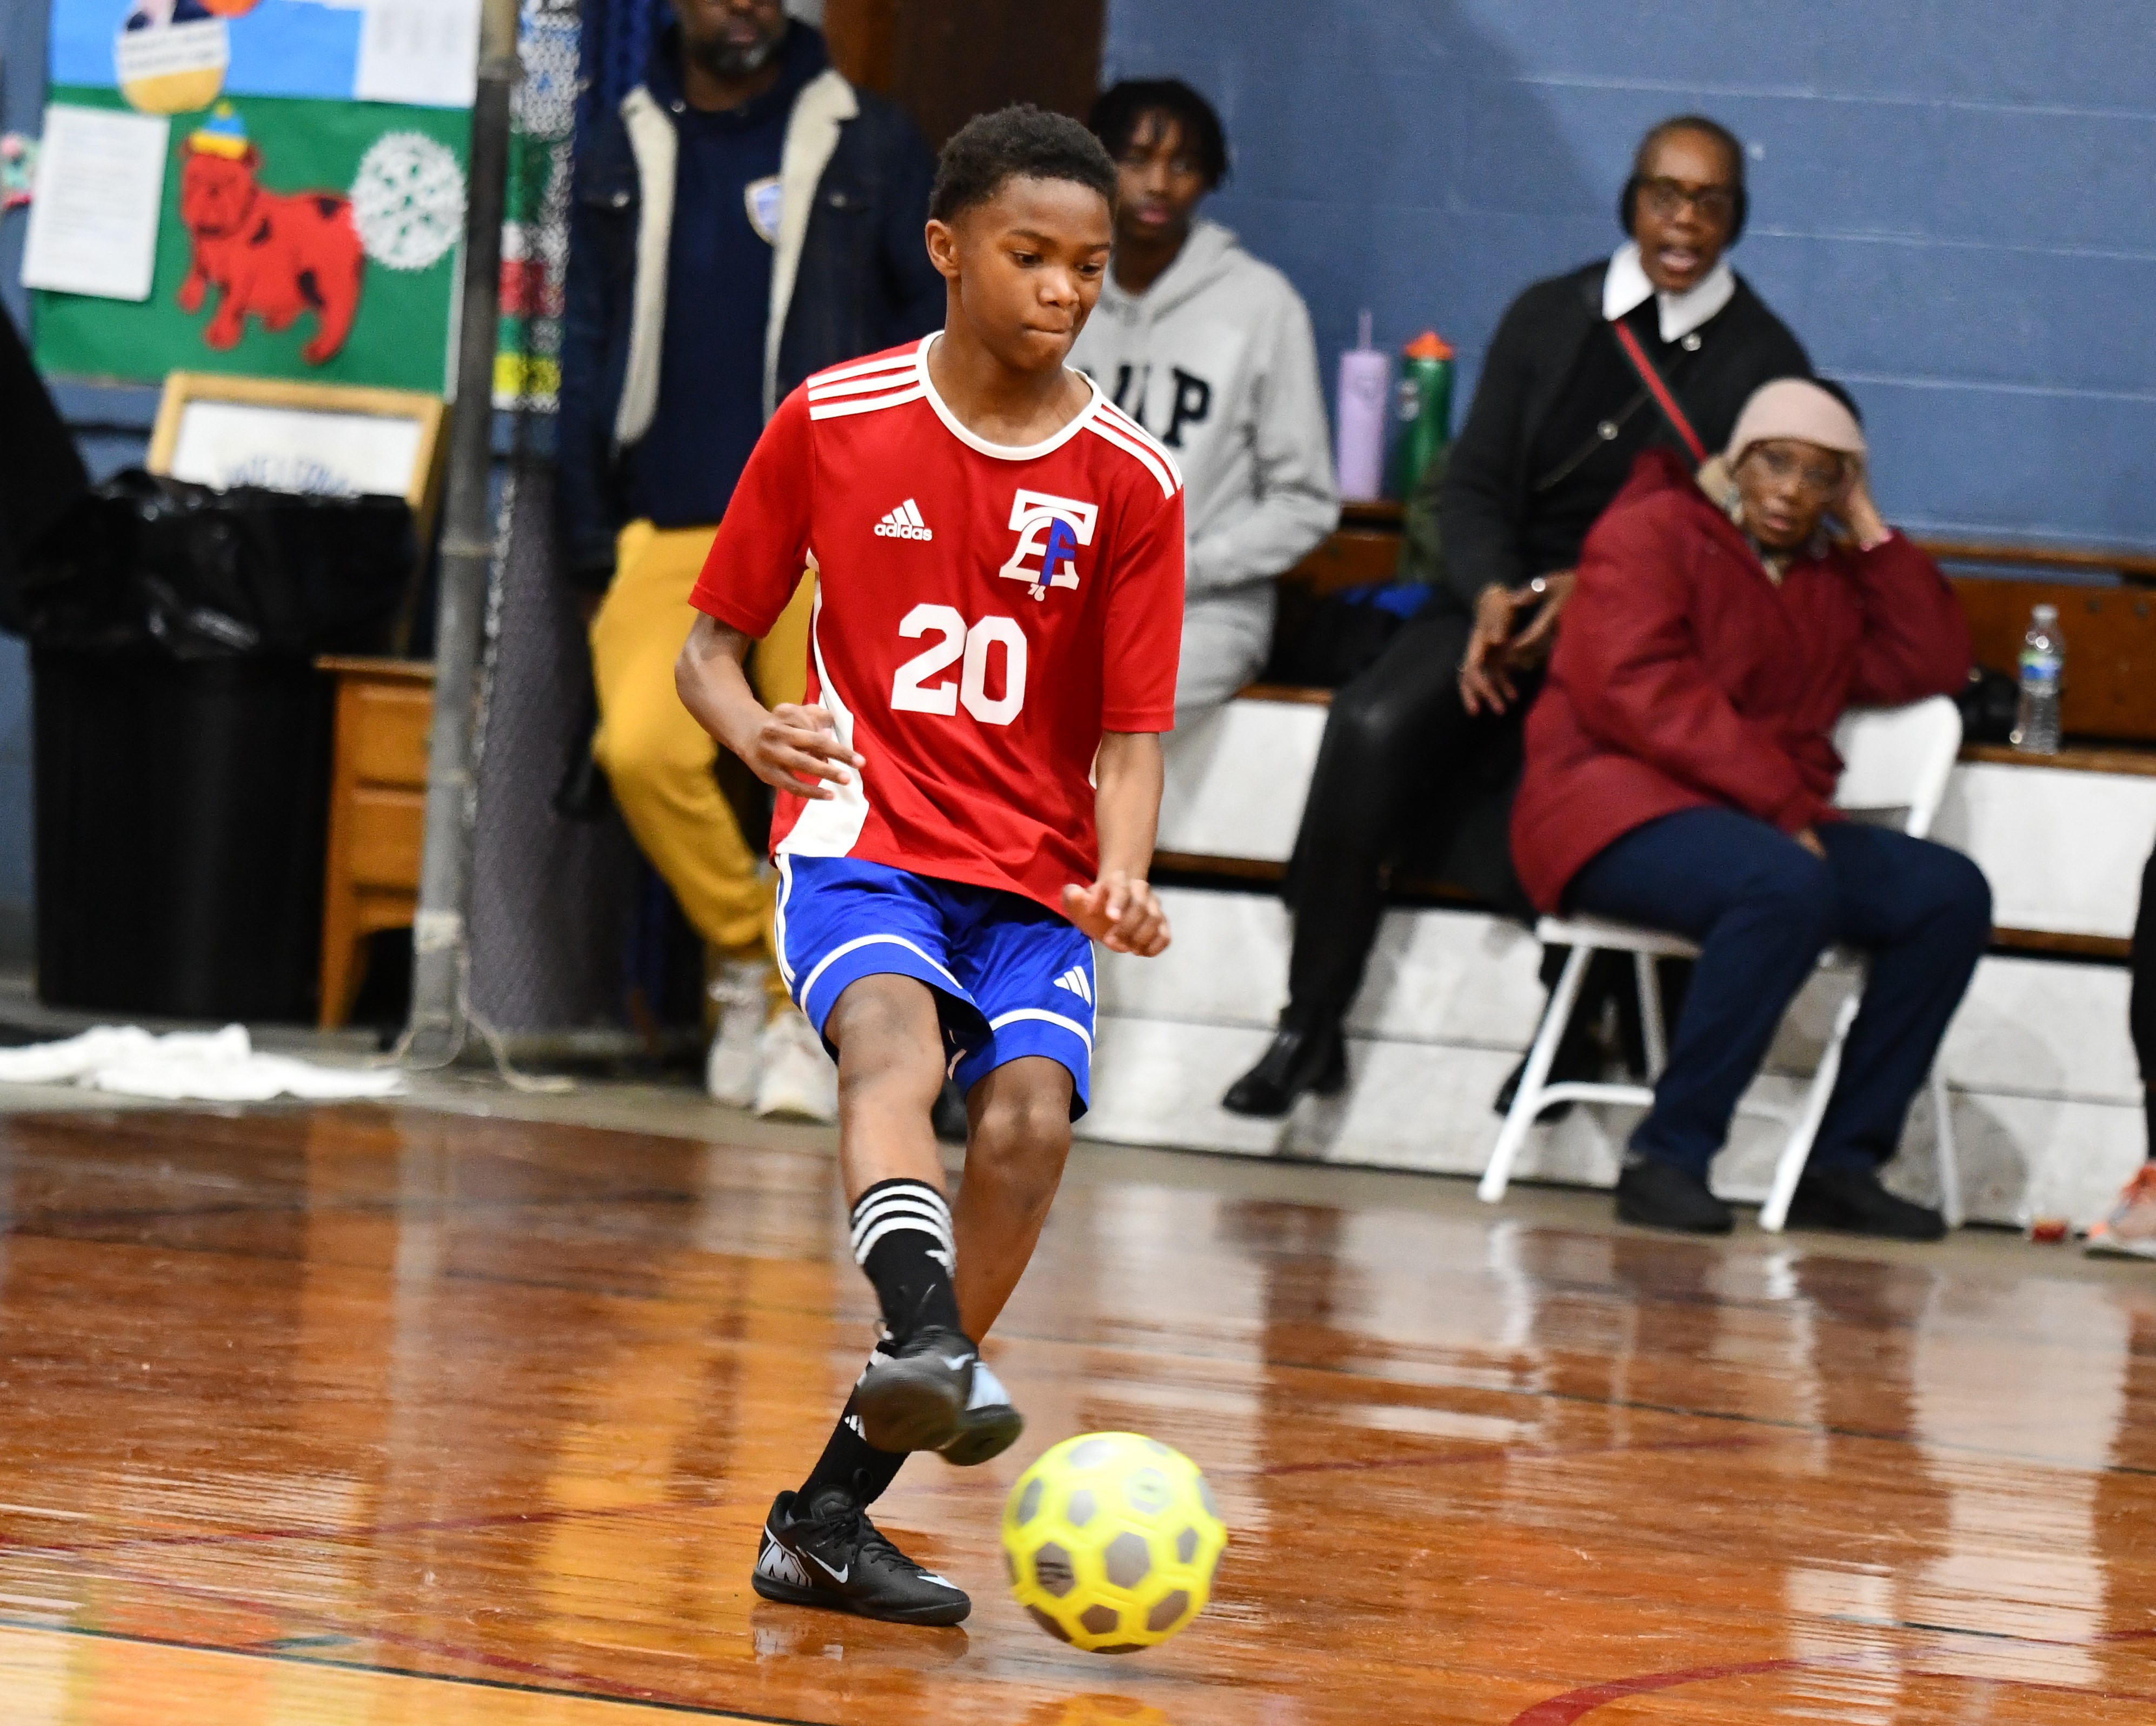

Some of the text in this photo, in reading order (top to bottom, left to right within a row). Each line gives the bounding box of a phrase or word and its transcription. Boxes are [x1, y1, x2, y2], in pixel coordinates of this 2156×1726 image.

[874, 522, 933, 541] adidas
[1027, 582, 1046, 601] 76
[891, 603, 1027, 726] 20
